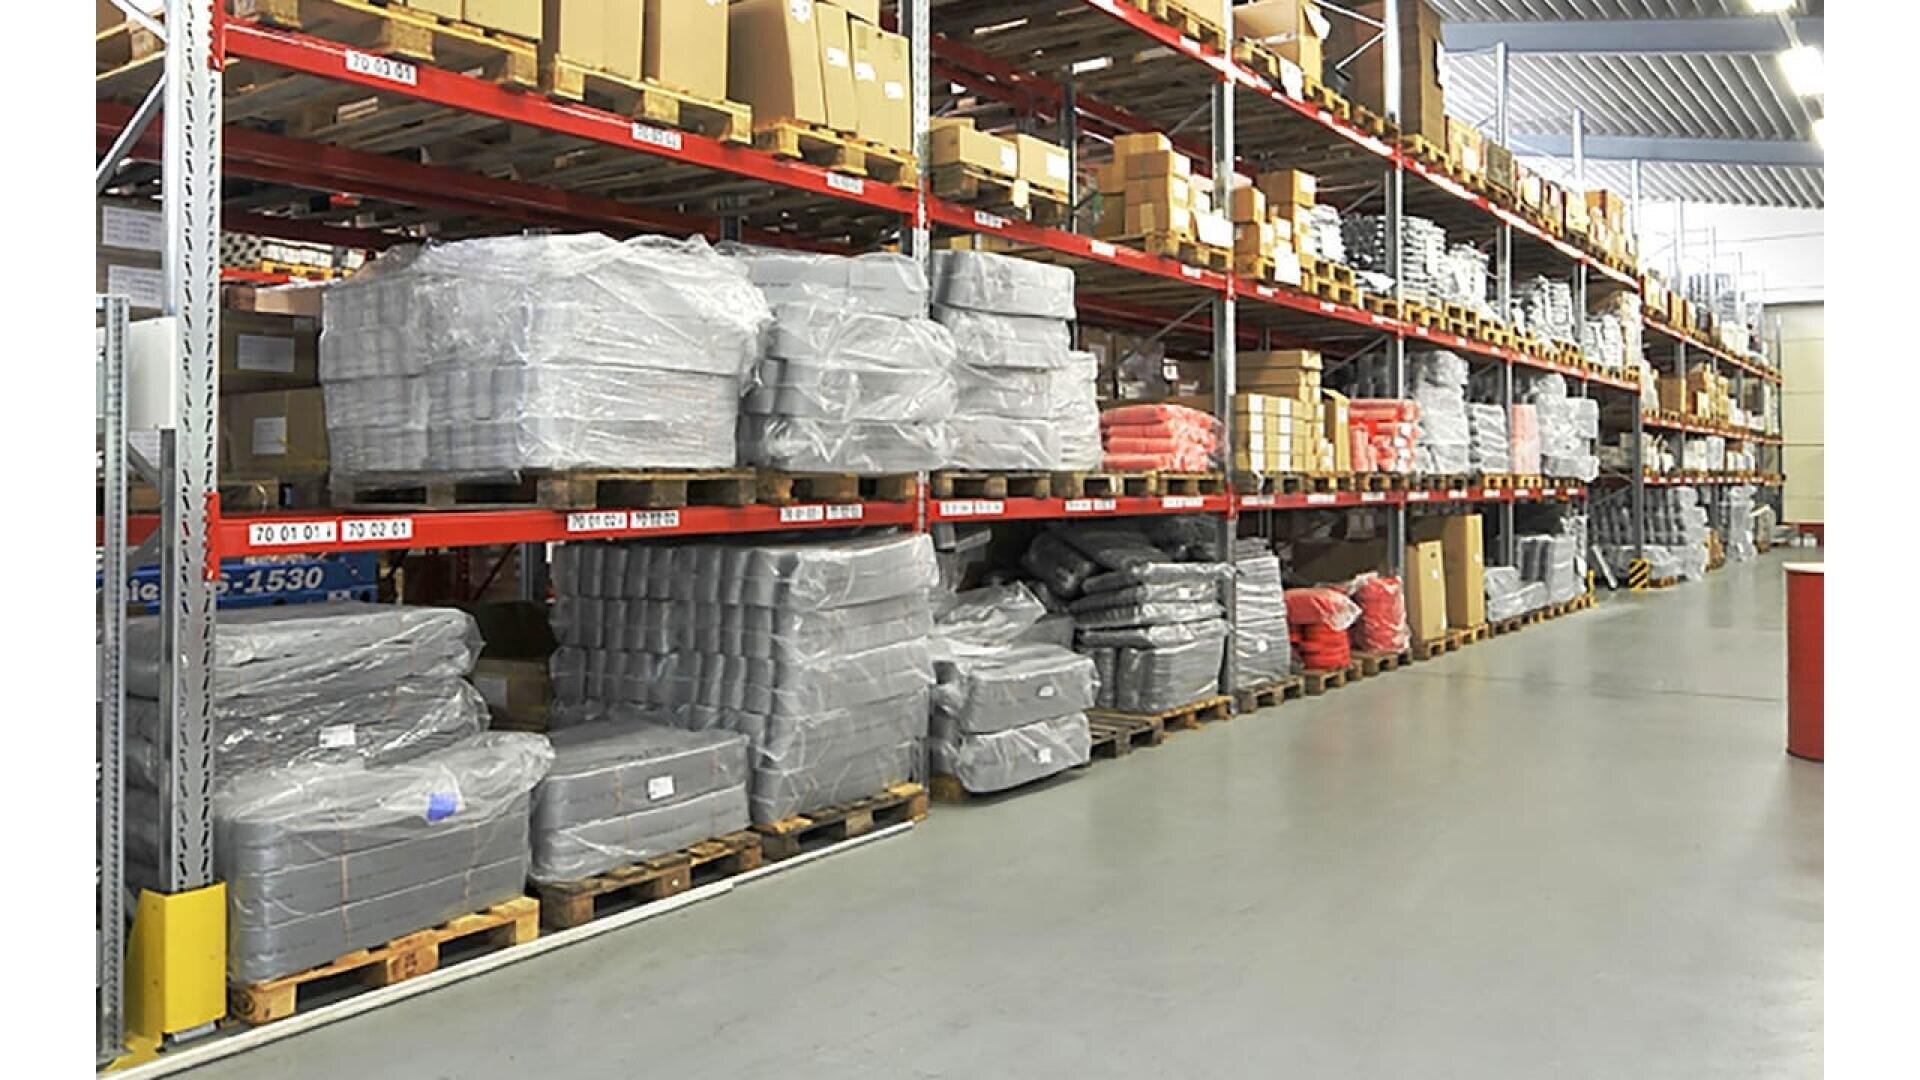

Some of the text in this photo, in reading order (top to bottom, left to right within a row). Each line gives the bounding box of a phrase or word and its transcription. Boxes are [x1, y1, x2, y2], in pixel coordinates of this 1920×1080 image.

[353, 53, 369, 71] 70
[257, 525, 320, 542] 70 01 01
[349, 523, 366, 538] 70
[392, 521, 406, 536] 01
[124, 579, 160, 601] ie
